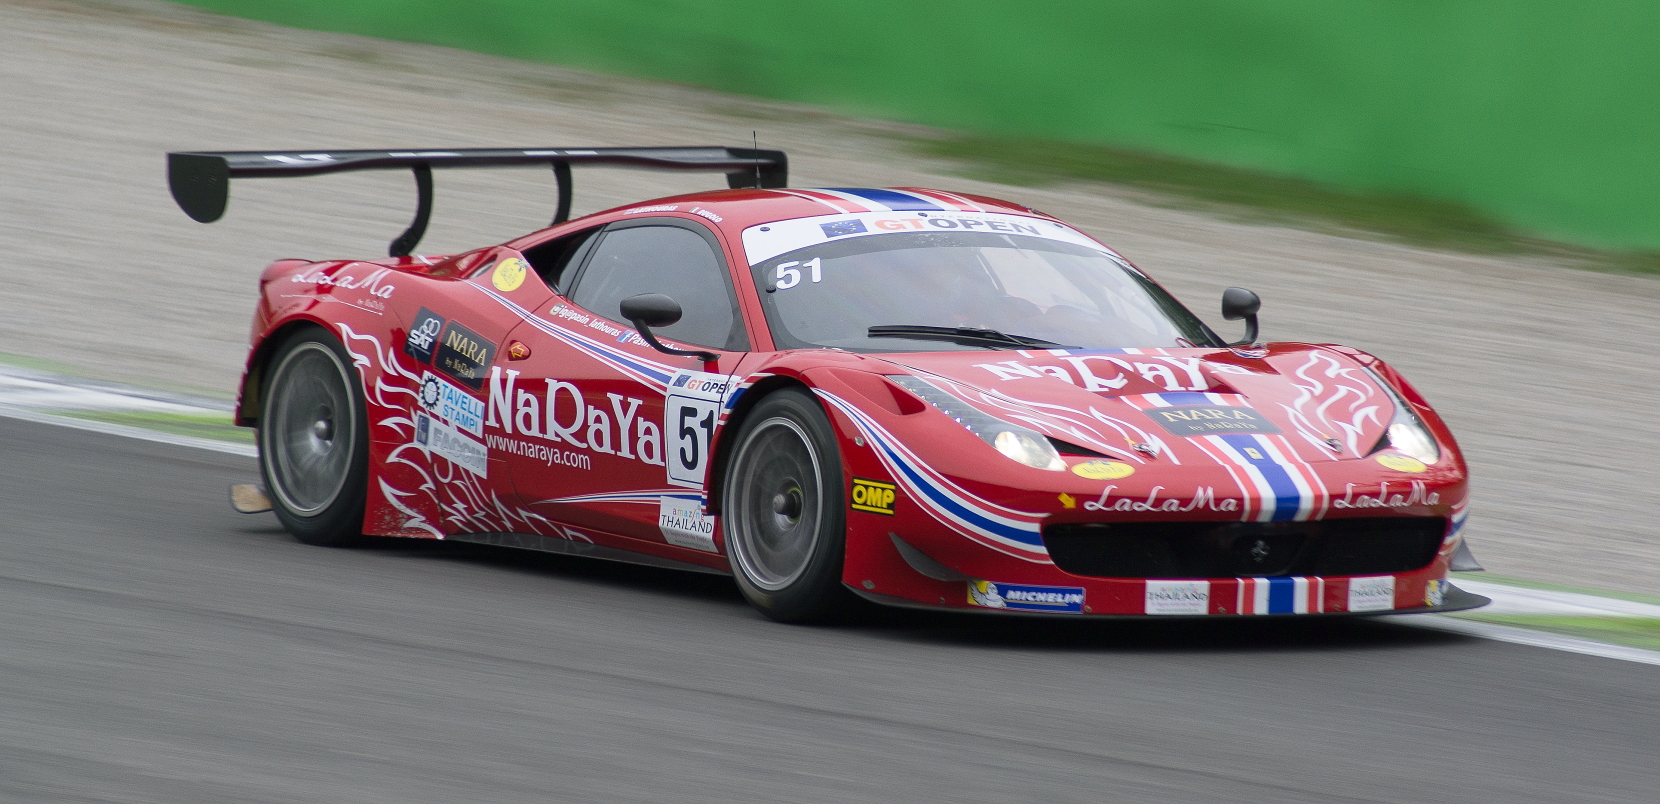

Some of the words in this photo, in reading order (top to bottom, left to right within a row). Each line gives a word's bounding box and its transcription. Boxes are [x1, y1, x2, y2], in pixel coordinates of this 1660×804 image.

[290, 260, 396, 299] LaLaMa
[776, 256, 822, 290] 51
[407, 329, 434, 350] SAT
[445, 329, 487, 367] NARA
[441, 383, 485, 420] TAVELLI
[484, 365, 666, 467] NaRaYa
[1160, 406, 1256, 424] NARA
[442, 404, 478, 433] STAMPI
[484, 433, 591, 471] www.naraya.com
[679, 405, 714, 471] 51
[852, 485, 896, 509] OMP
[1082, 484, 1239, 512] LaLaMa
[1333, 479, 1441, 510] LaLaMa
[661, 514, 713, 534] THAILAND
[1005, 589, 1084, 604] MICHELIN
